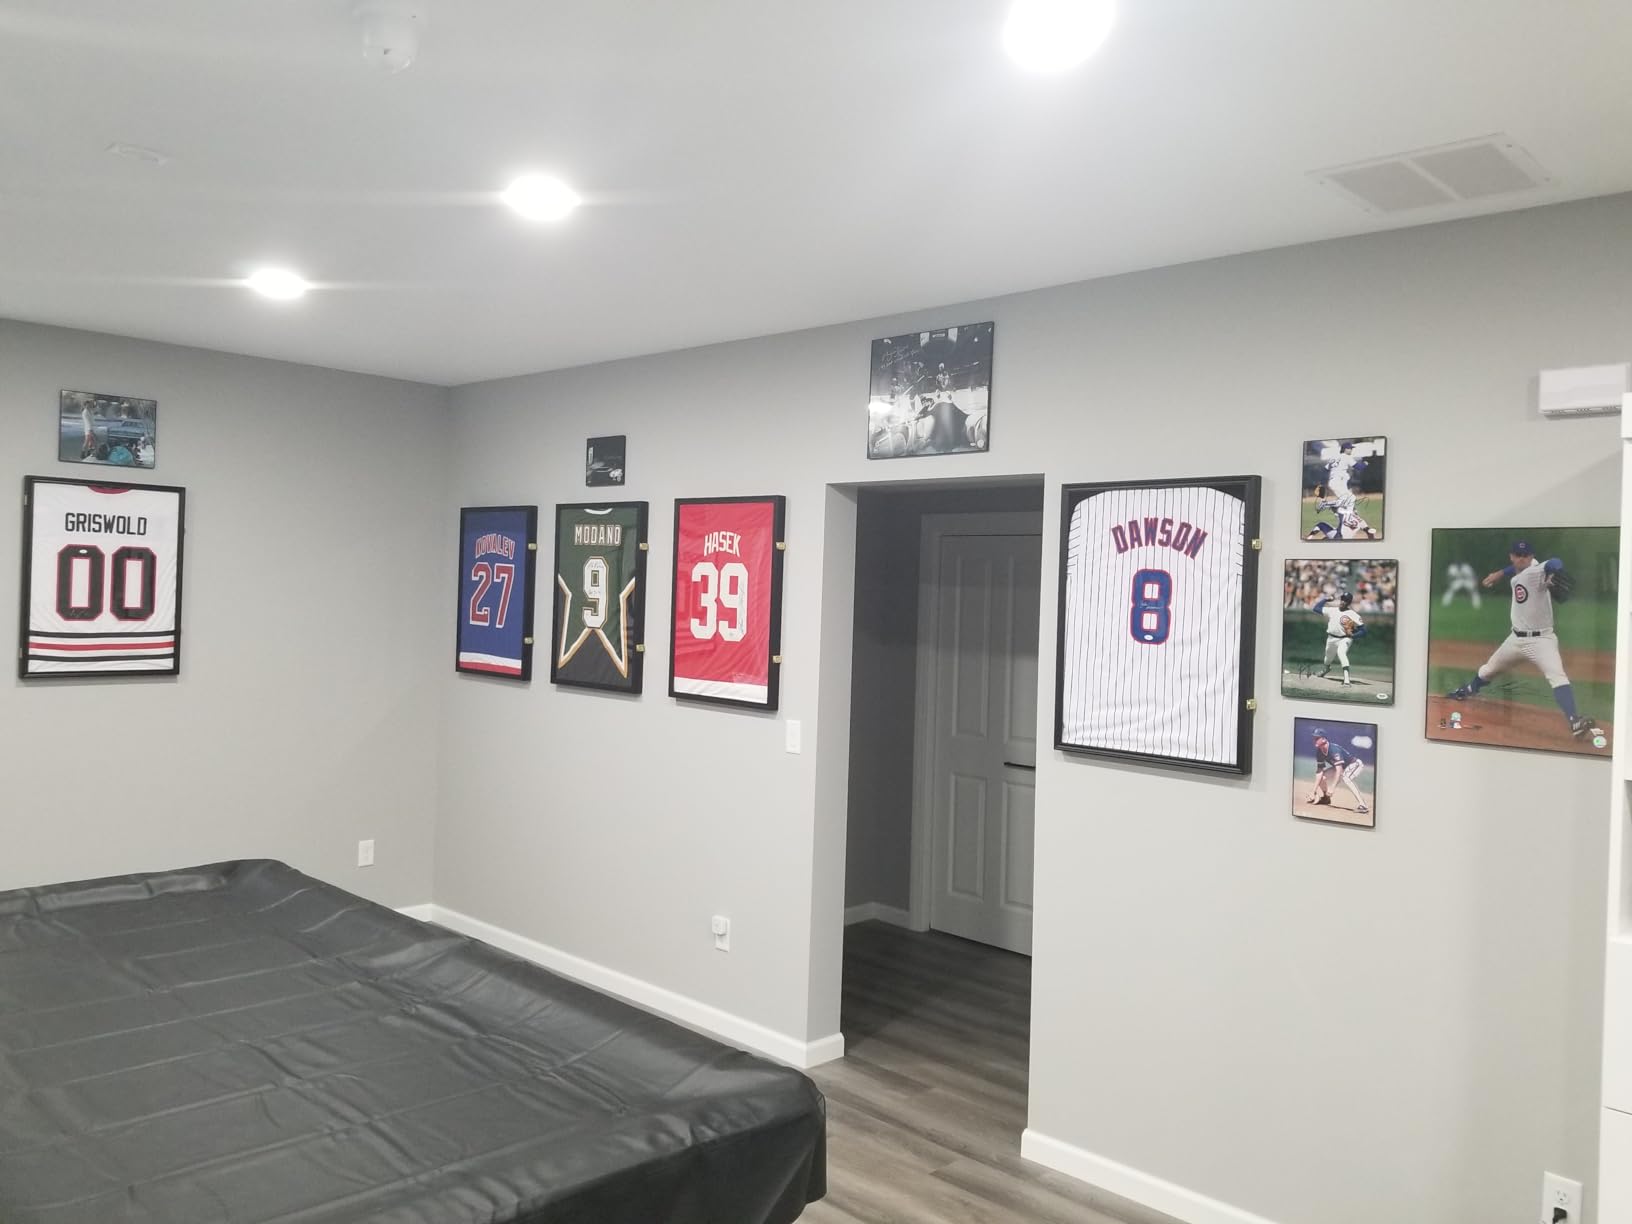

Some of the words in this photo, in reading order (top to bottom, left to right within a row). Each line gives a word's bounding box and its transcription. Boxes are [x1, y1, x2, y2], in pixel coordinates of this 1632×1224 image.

[65, 512, 147, 536] GRISWOLD
[574, 524, 622, 547] MODANO
[703, 531, 741, 557] HASEK
[1111, 517, 1208, 559] DAWSON
[56, 544, 157, 621] 00
[469, 561, 515, 629] 27
[582, 556, 609, 630] 9
[689, 561, 749, 642] 39
[1130, 568, 1173, 646] 8
